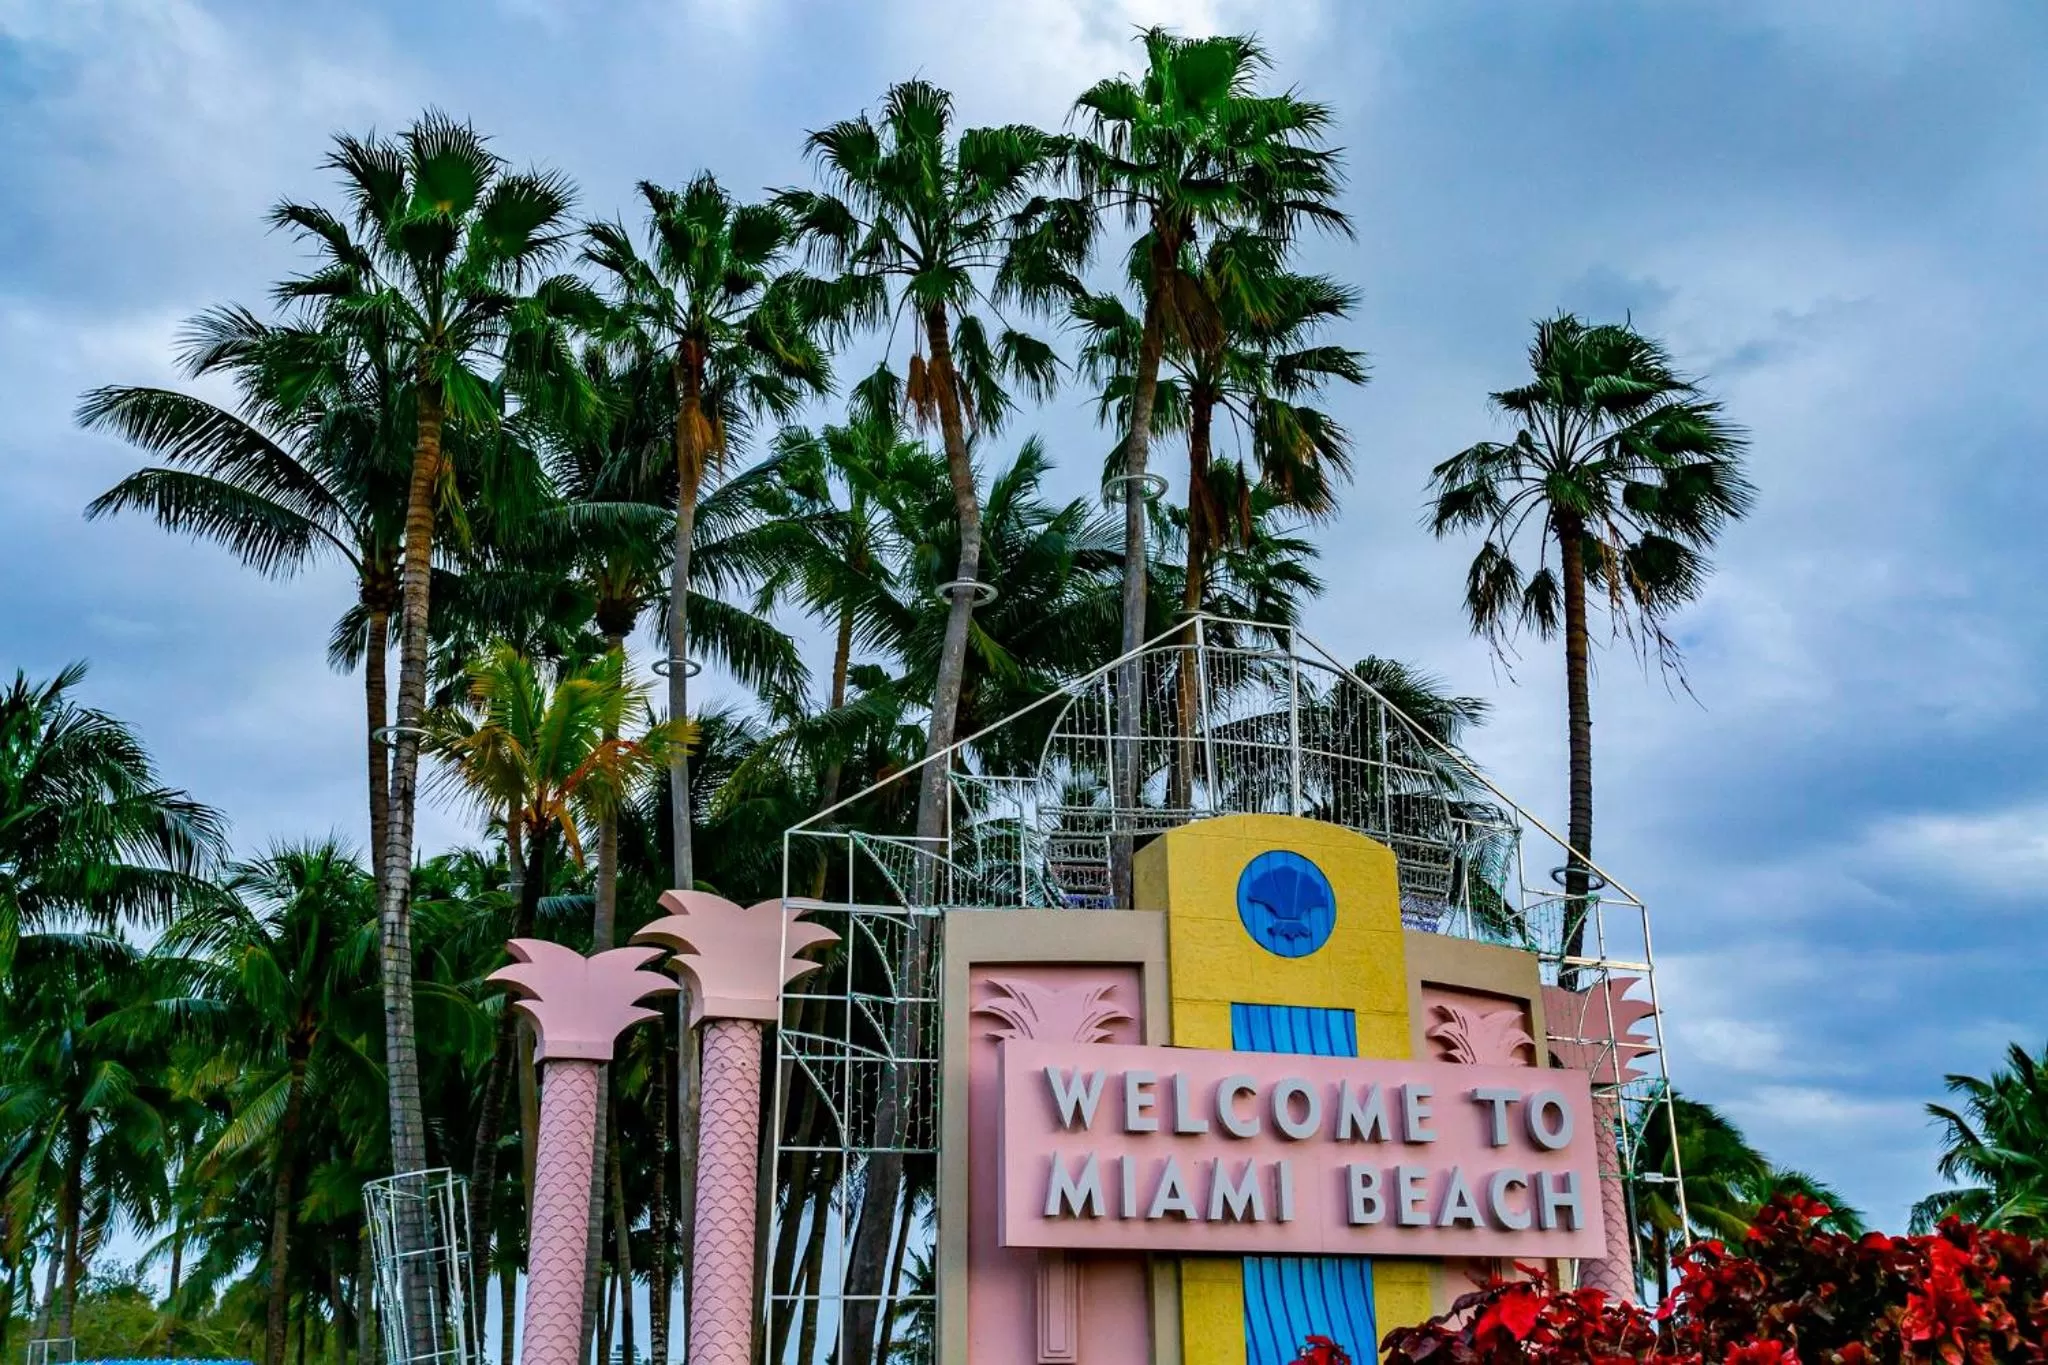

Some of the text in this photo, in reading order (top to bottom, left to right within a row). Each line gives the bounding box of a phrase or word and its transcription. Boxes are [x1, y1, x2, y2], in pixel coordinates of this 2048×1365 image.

[1044, 1066, 1573, 1150] WELCOME TO
[1045, 1152, 1583, 1230] MIAMI BEACH
